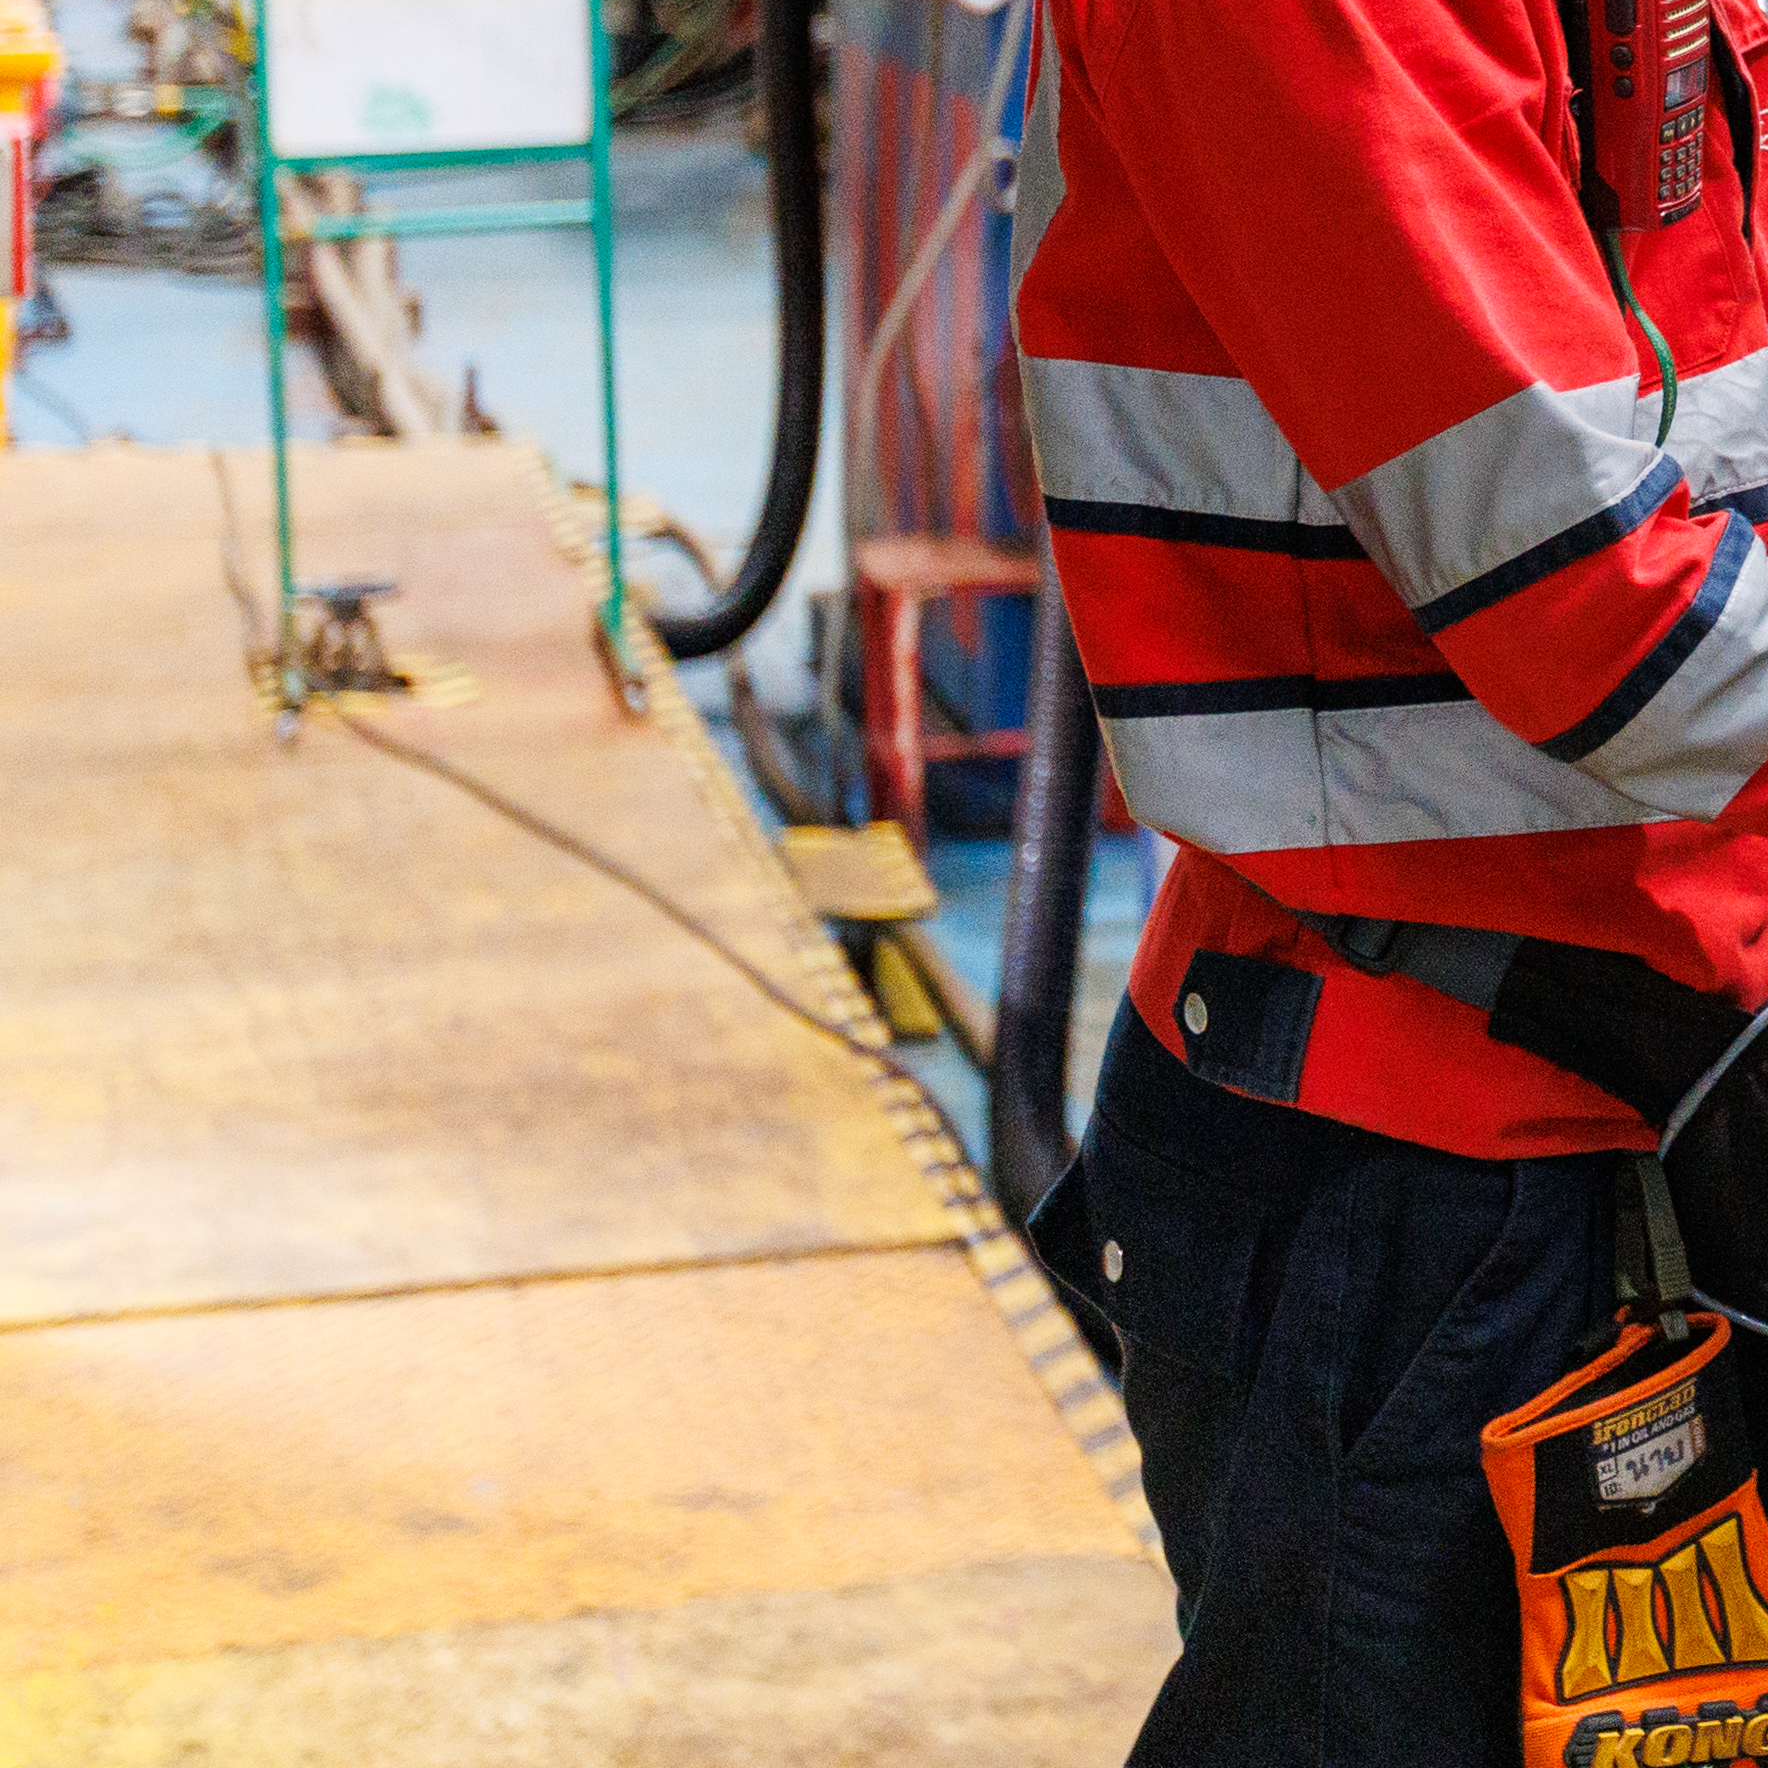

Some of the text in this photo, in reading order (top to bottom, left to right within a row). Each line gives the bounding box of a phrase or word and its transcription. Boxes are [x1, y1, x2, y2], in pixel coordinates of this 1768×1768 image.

[1617, 1436, 1631, 1451] IN
[1650, 1413, 1674, 1436] AND
[1676, 1402, 1696, 1422] GAS
